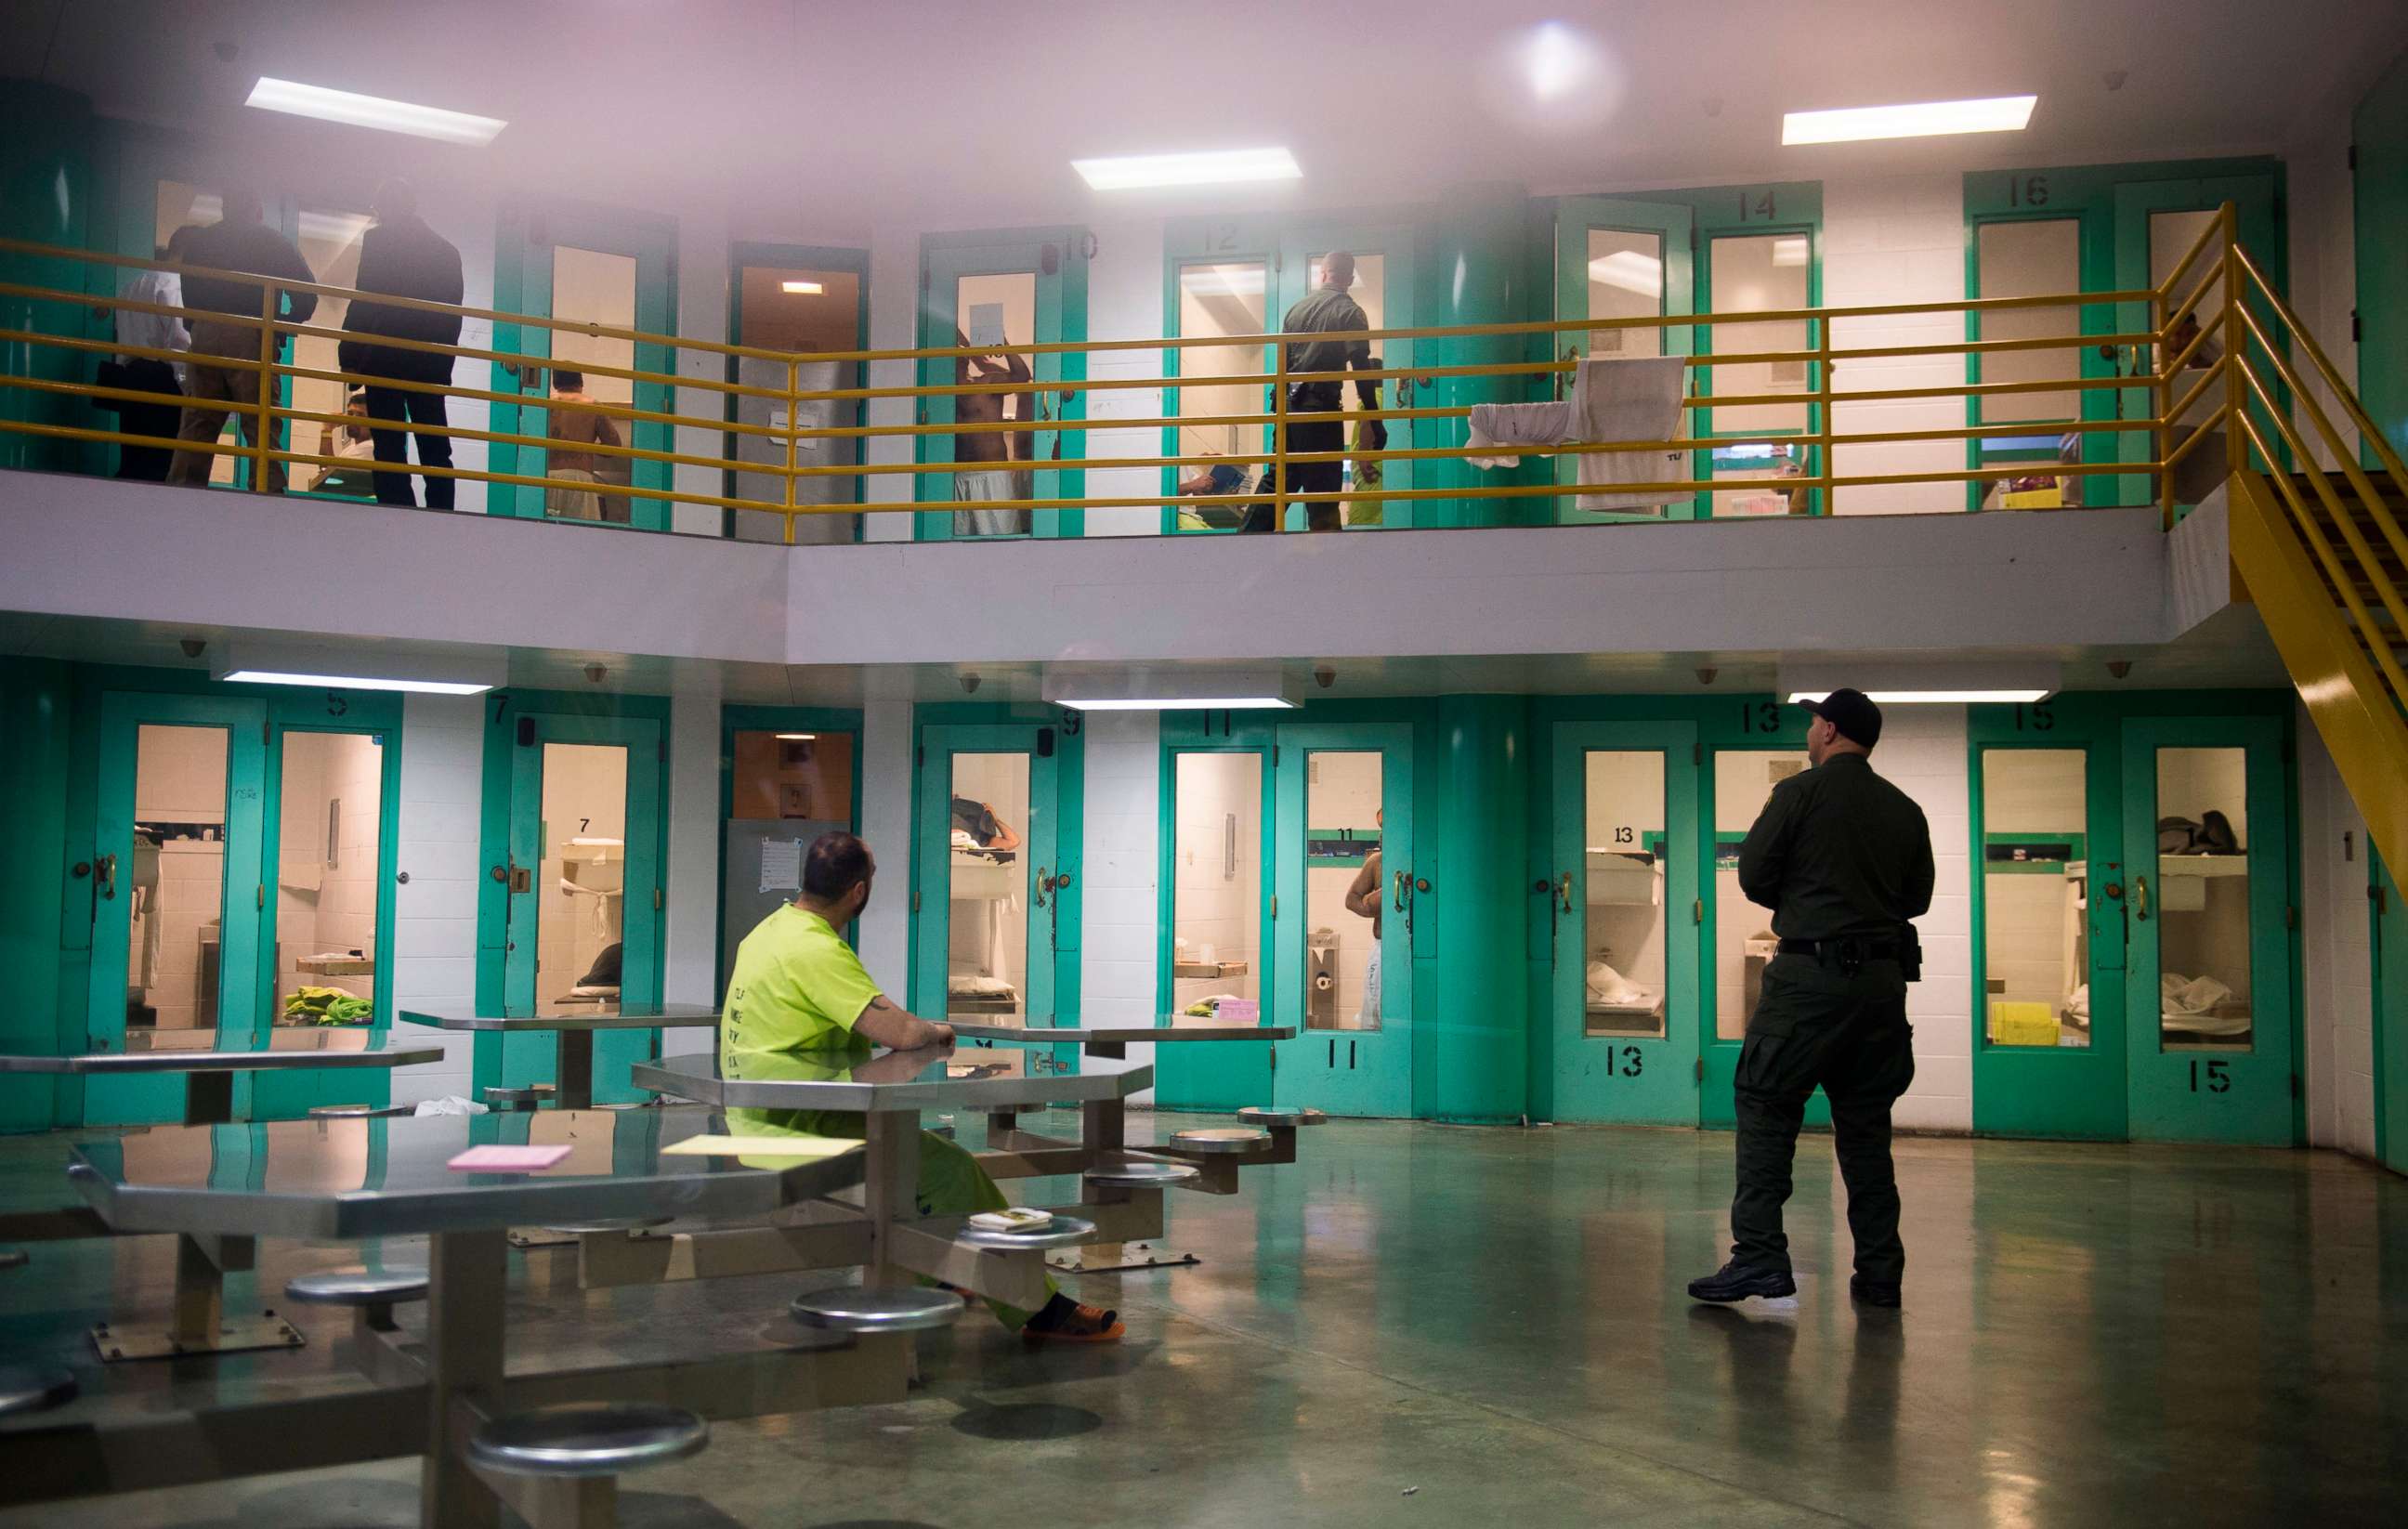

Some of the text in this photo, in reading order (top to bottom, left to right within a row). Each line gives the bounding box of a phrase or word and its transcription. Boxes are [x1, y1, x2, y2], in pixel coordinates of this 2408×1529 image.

[2010, 176, 2049, 207] 16
[1739, 191, 1776, 223] 14
[1067, 230, 1097, 260] 10
[1205, 224, 1238, 251] 12
[328, 688, 347, 717] 5
[491, 695, 508, 724] 7
[2016, 702, 2053, 731] 15
[1063, 707, 1080, 736] 9
[1205, 709, 1230, 737] 11
[1744, 702, 1780, 733] 13
[580, 818, 590, 832] 7
[1338, 828, 1352, 842] 11
[1615, 827, 1633, 843] 13
[1329, 1039, 1355, 1069] 11
[1607, 1046, 1642, 1077] 13
[2191, 1060, 2231, 1092] 15
